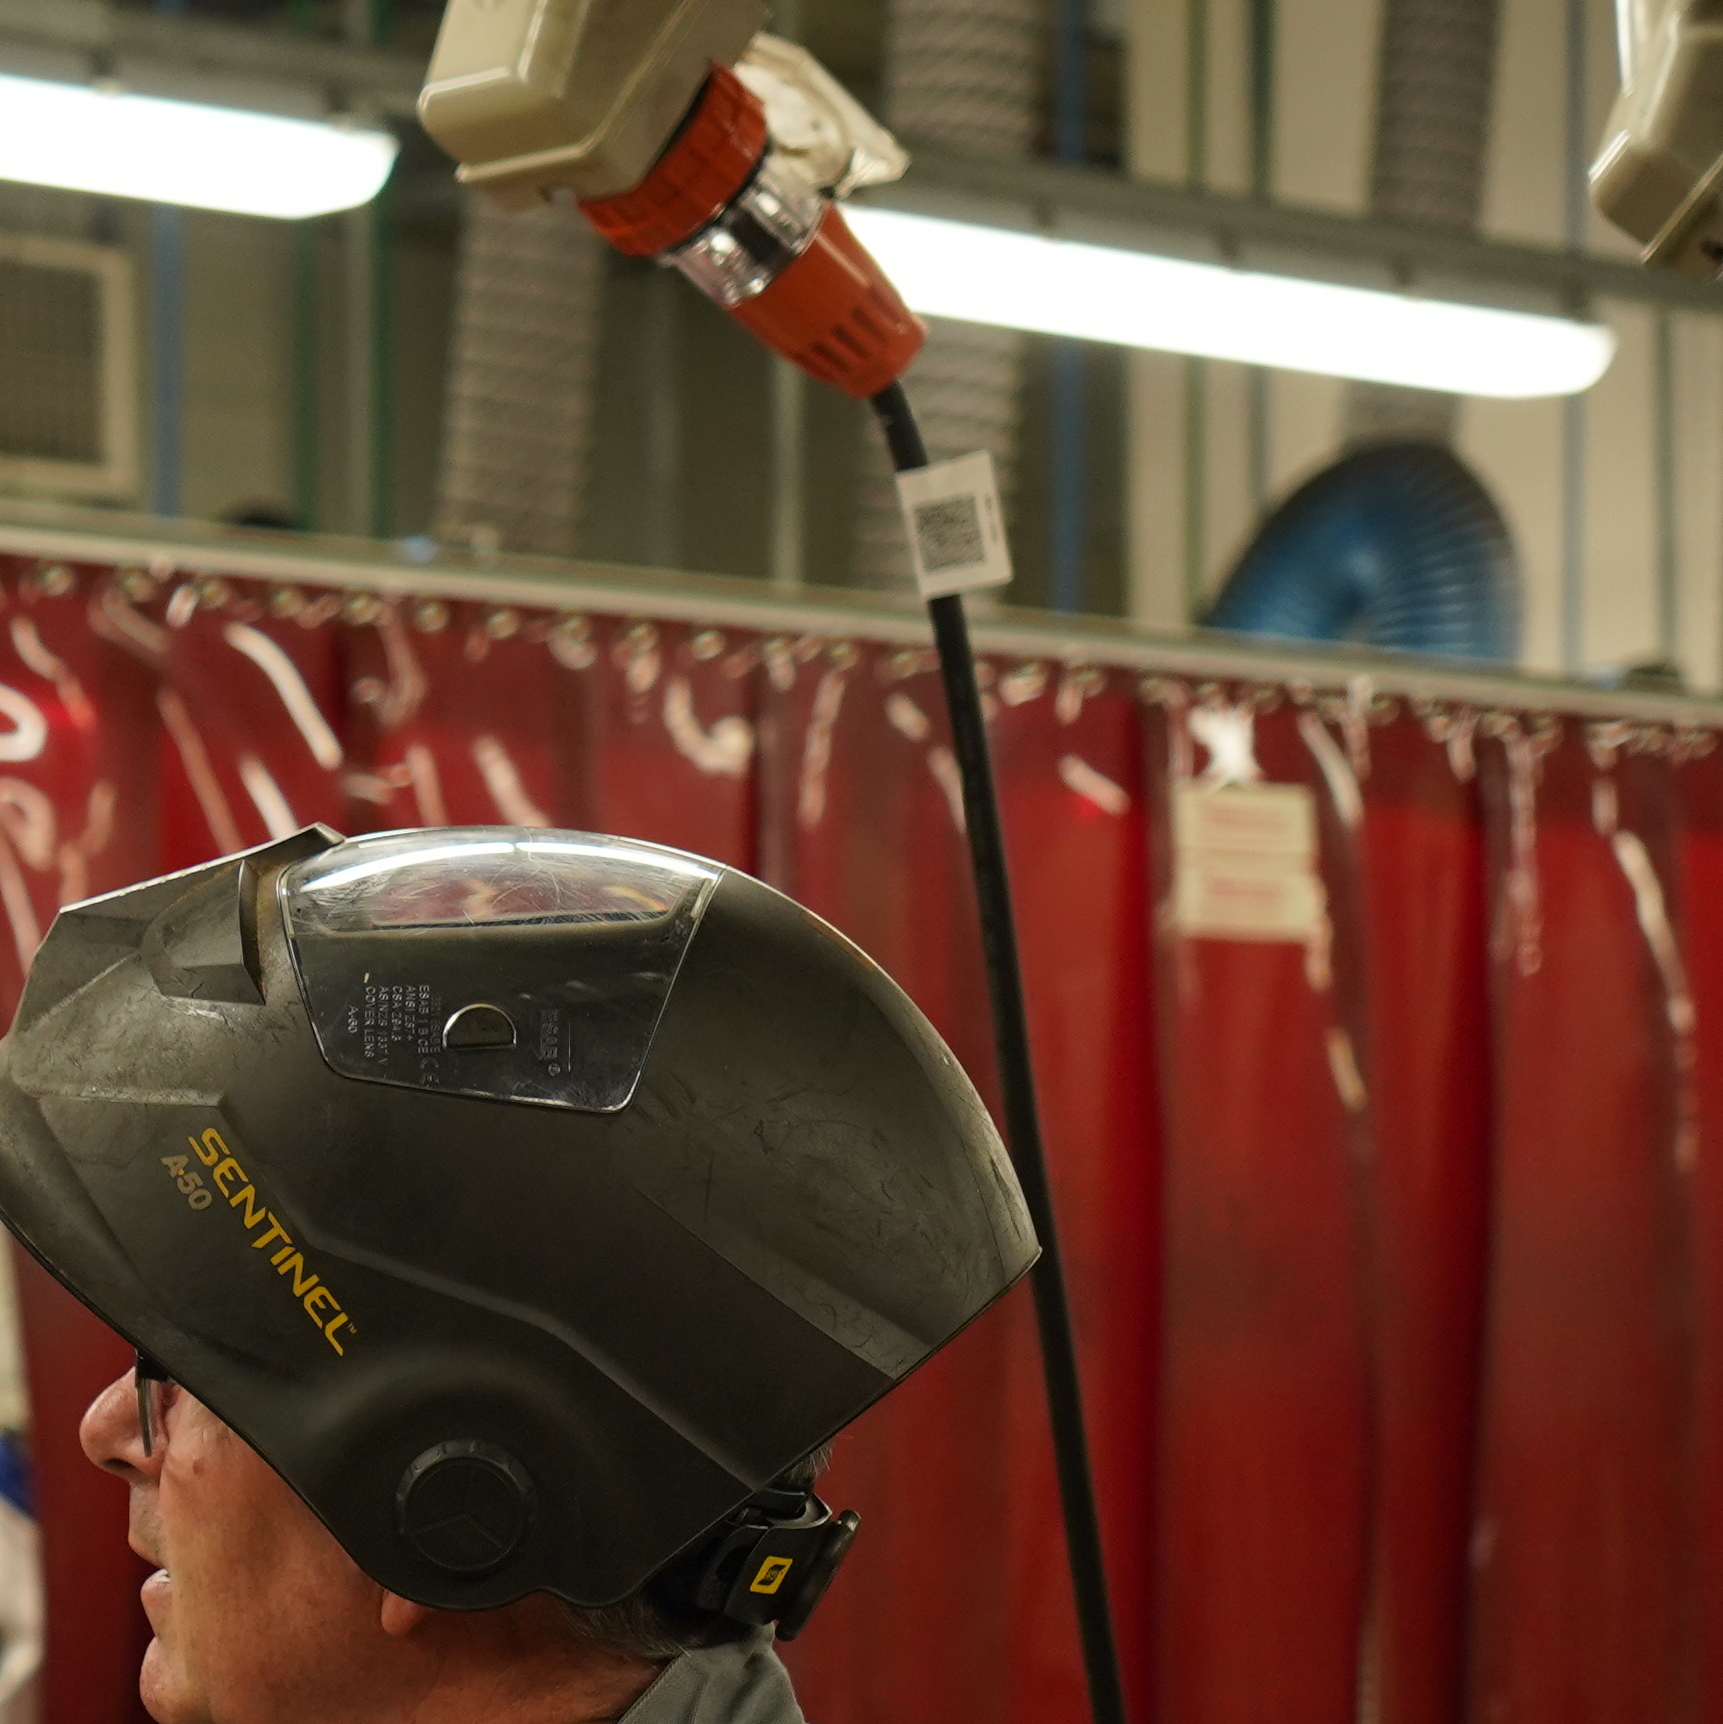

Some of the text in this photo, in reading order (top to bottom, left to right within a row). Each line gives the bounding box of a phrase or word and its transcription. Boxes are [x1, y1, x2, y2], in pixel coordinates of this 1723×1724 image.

[364, 986, 376, 1058] COVER LENS
[188, 1128, 348, 1356] SENTINEL
